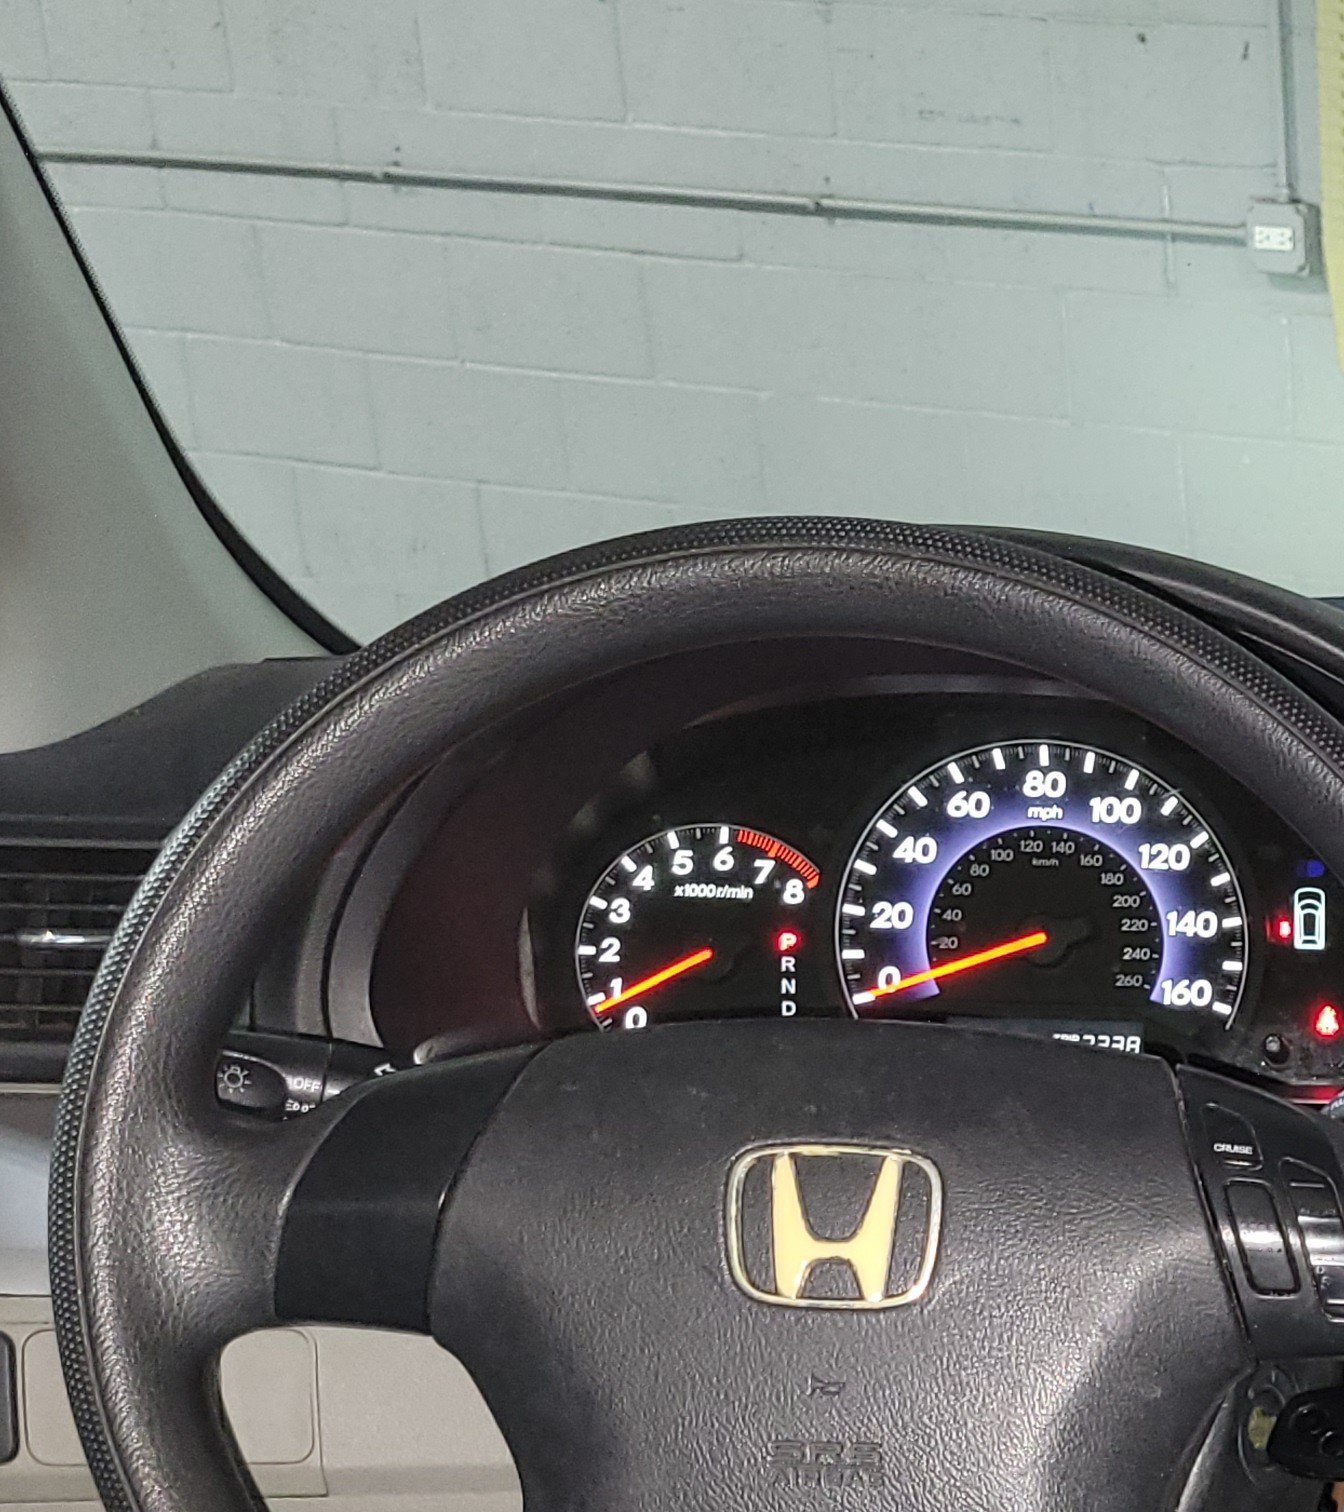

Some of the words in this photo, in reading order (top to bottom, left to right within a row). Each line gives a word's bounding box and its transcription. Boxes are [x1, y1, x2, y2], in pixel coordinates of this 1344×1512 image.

[1023, 770, 1066, 798] 80
[947, 791, 990, 818] 60
[1090, 797, 1141, 824] 100
[1027, 805, 1063, 820] mph
[893, 836, 937, 864] 40
[1021, 840, 1043, 852] 120
[1052, 842, 1075, 854] 140
[672, 850, 693, 875] 5
[713, 846, 734, 871] 6
[991, 849, 1013, 861] 100
[1032, 858, 1059, 866] km/h
[1080, 854, 1102, 866] 160
[1139, 844, 1190, 871] 120
[632, 865, 654, 890] 4
[754, 859, 775, 884] 7
[970, 864, 989, 876] 80
[1101, 873, 1123, 885] 180
[783, 879, 804, 904] 8
[952, 883, 971, 895] 60
[1113, 895, 1140, 907] 200
[609, 898, 630, 923] 3
[870, 902, 914, 929] 20
[943, 909, 962, 921] 40
[1121, 919, 1148, 931] 220
[1166, 911, 1217, 938] 140
[599, 937, 620, 962] 2
[778, 933, 797, 951] P
[938, 937, 958, 949] 20
[1123, 948, 1150, 960] 240
[781, 956, 795, 971] R
[782, 978, 795, 993] N
[878, 966, 900, 992] 0
[1115, 974, 1142, 986] 260
[609, 977, 622, 998] 1
[1161, 979, 1212, 1007] 160
[782, 1001, 796, 1016] D
[625, 1006, 647, 1029] 0
[294, 1077, 321, 1092] OFF
[1214, 1144, 1252, 1154] CRUISE
